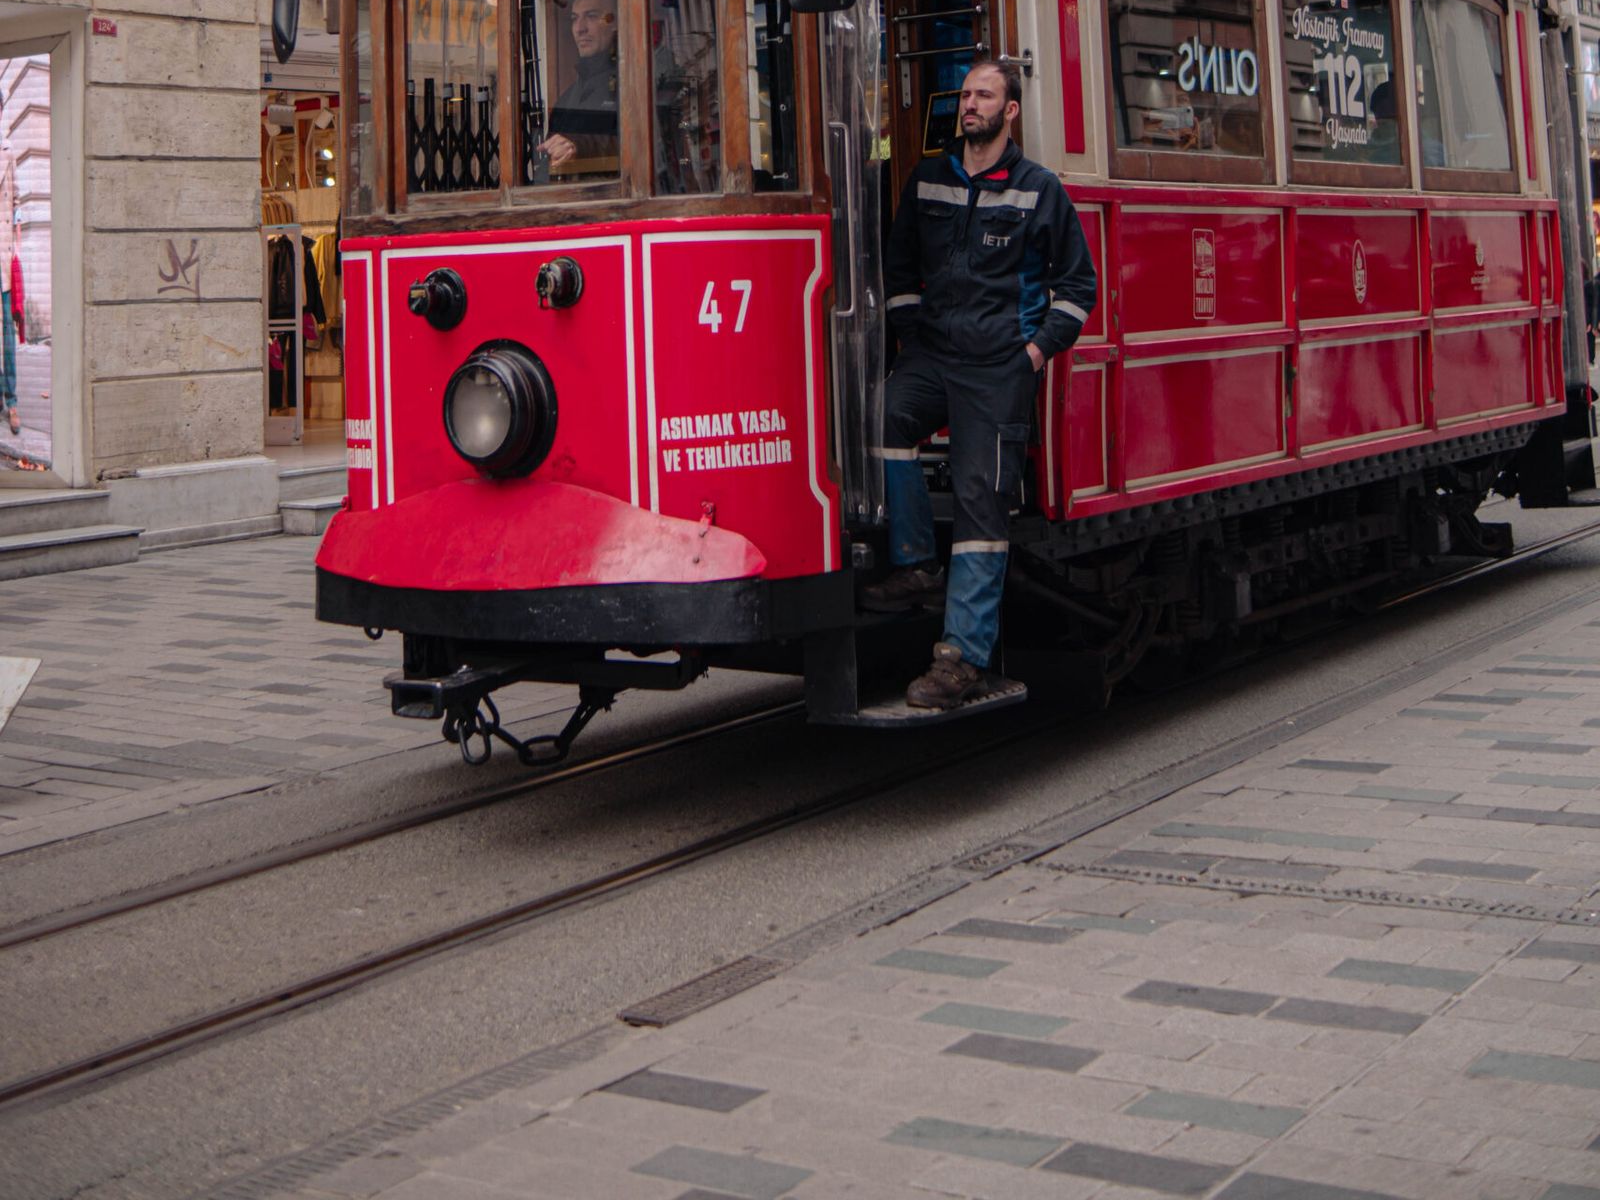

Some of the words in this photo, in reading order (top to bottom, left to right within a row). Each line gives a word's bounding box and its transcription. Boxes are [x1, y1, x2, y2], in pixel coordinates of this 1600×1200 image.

[1292, 5, 1340, 48] Nostaljik
[1342, 17, 1384, 59] Tramvay
[1323, 52, 1365, 118] 112
[1326, 117, 1368, 150] Yaşında
[698, 279, 752, 333] 47
[661, 412, 735, 441] ASILMAK
[663, 448, 682, 473] VE
[686, 436, 792, 472] TEHLİKELİDİR
